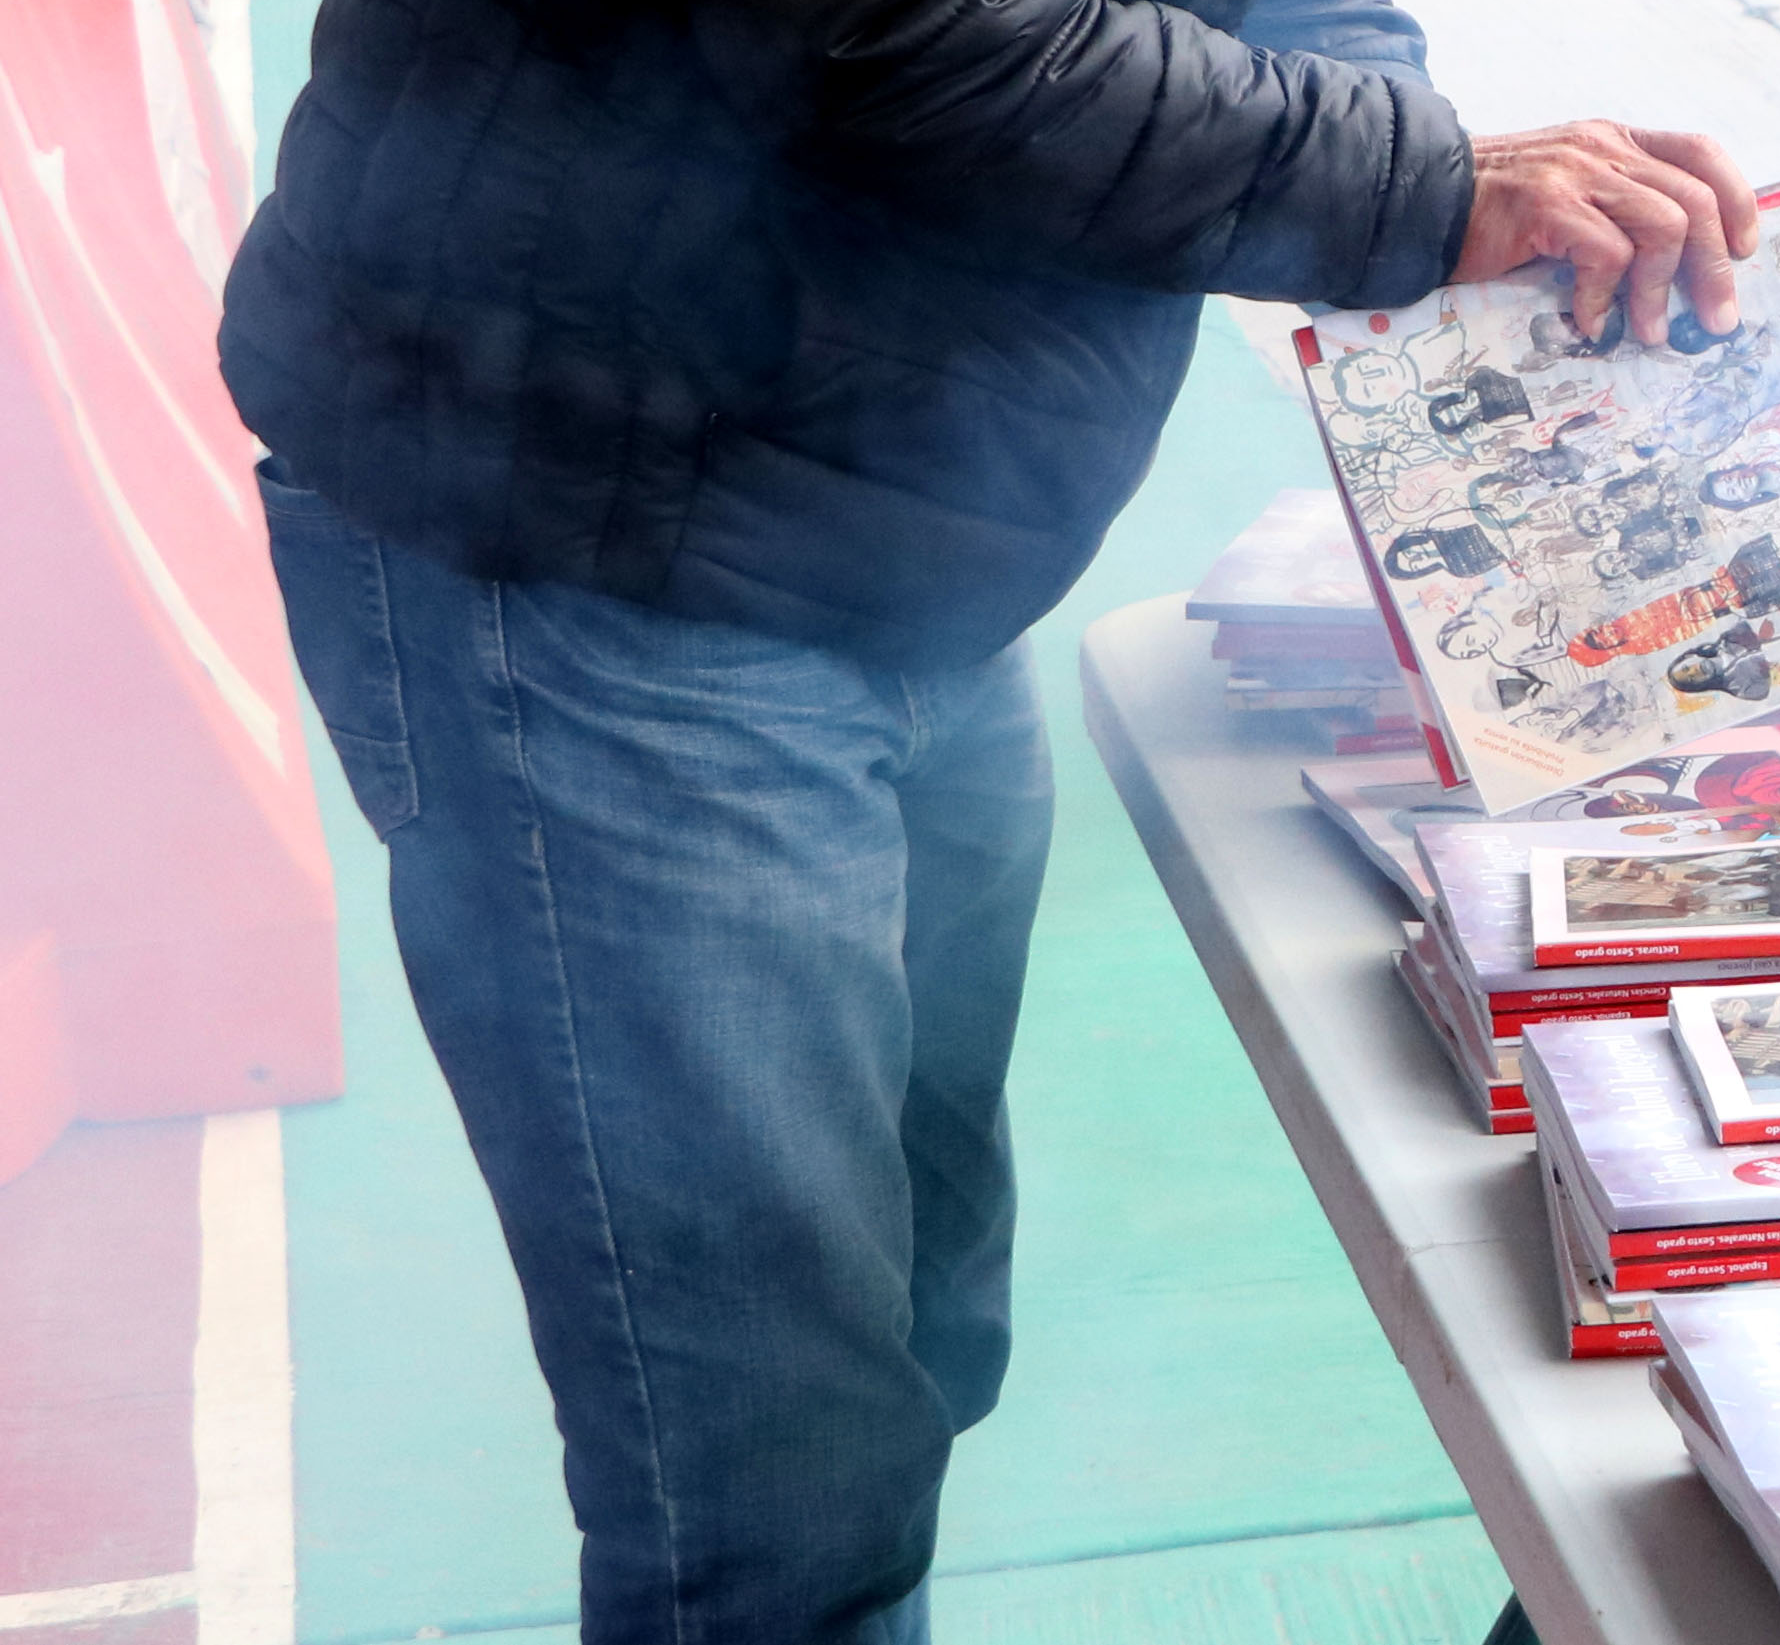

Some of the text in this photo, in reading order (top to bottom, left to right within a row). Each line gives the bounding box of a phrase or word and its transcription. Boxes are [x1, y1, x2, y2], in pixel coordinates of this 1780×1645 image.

[1474, 738, 1509, 755] gratuita
[1483, 728, 1565, 765] Prohibida su venta
[1575, 945, 1680, 960] Lecturas. Sexto grado
[1531, 987, 1667, 1005] Ciencias Naturales. Sexto grado
[1584, 1034, 1670, 1084] Integral
[1656, 1236, 1686, 1250] grado
[1687, 1236, 1716, 1248] Sexto
[1717, 1232, 1766, 1245] Naturales.
[1667, 1260, 1768, 1279] Español. Sexto grado
[1618, 1327, 1649, 1340] grado
